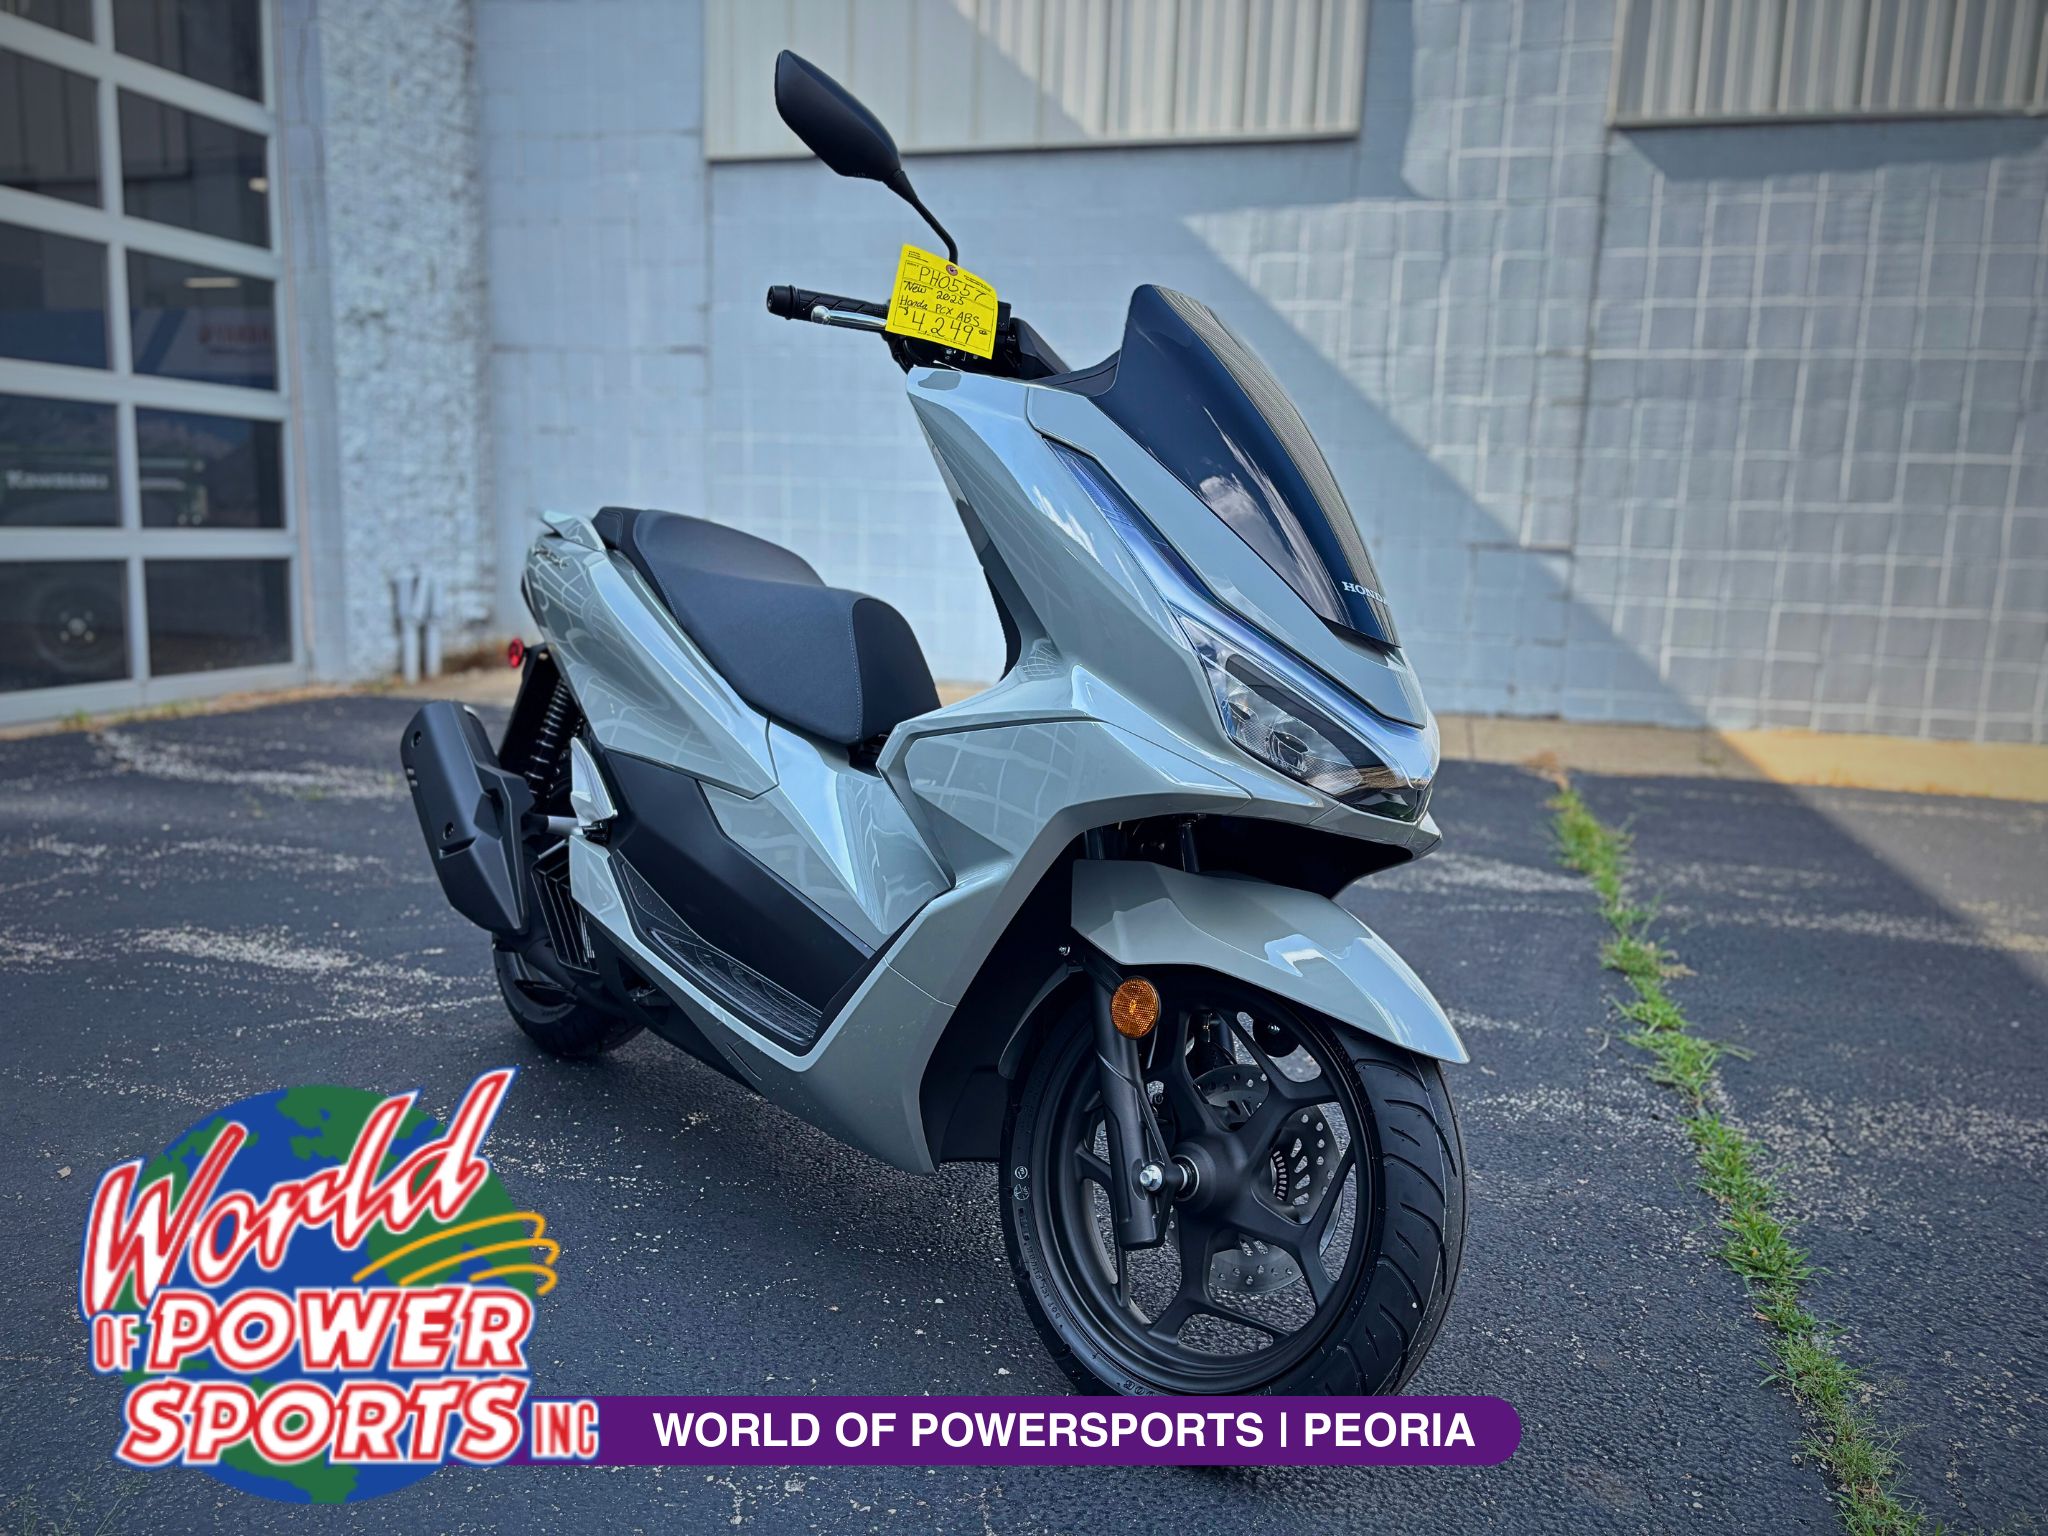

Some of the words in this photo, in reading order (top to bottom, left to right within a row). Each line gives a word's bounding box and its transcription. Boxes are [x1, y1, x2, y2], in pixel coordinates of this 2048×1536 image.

[904, 280, 927, 294] New
[936, 290, 965, 305] 2025
[899, 294, 928, 311] Honda
[935, 303, 954, 316] PCX
[956, 311, 980, 328] ABS
